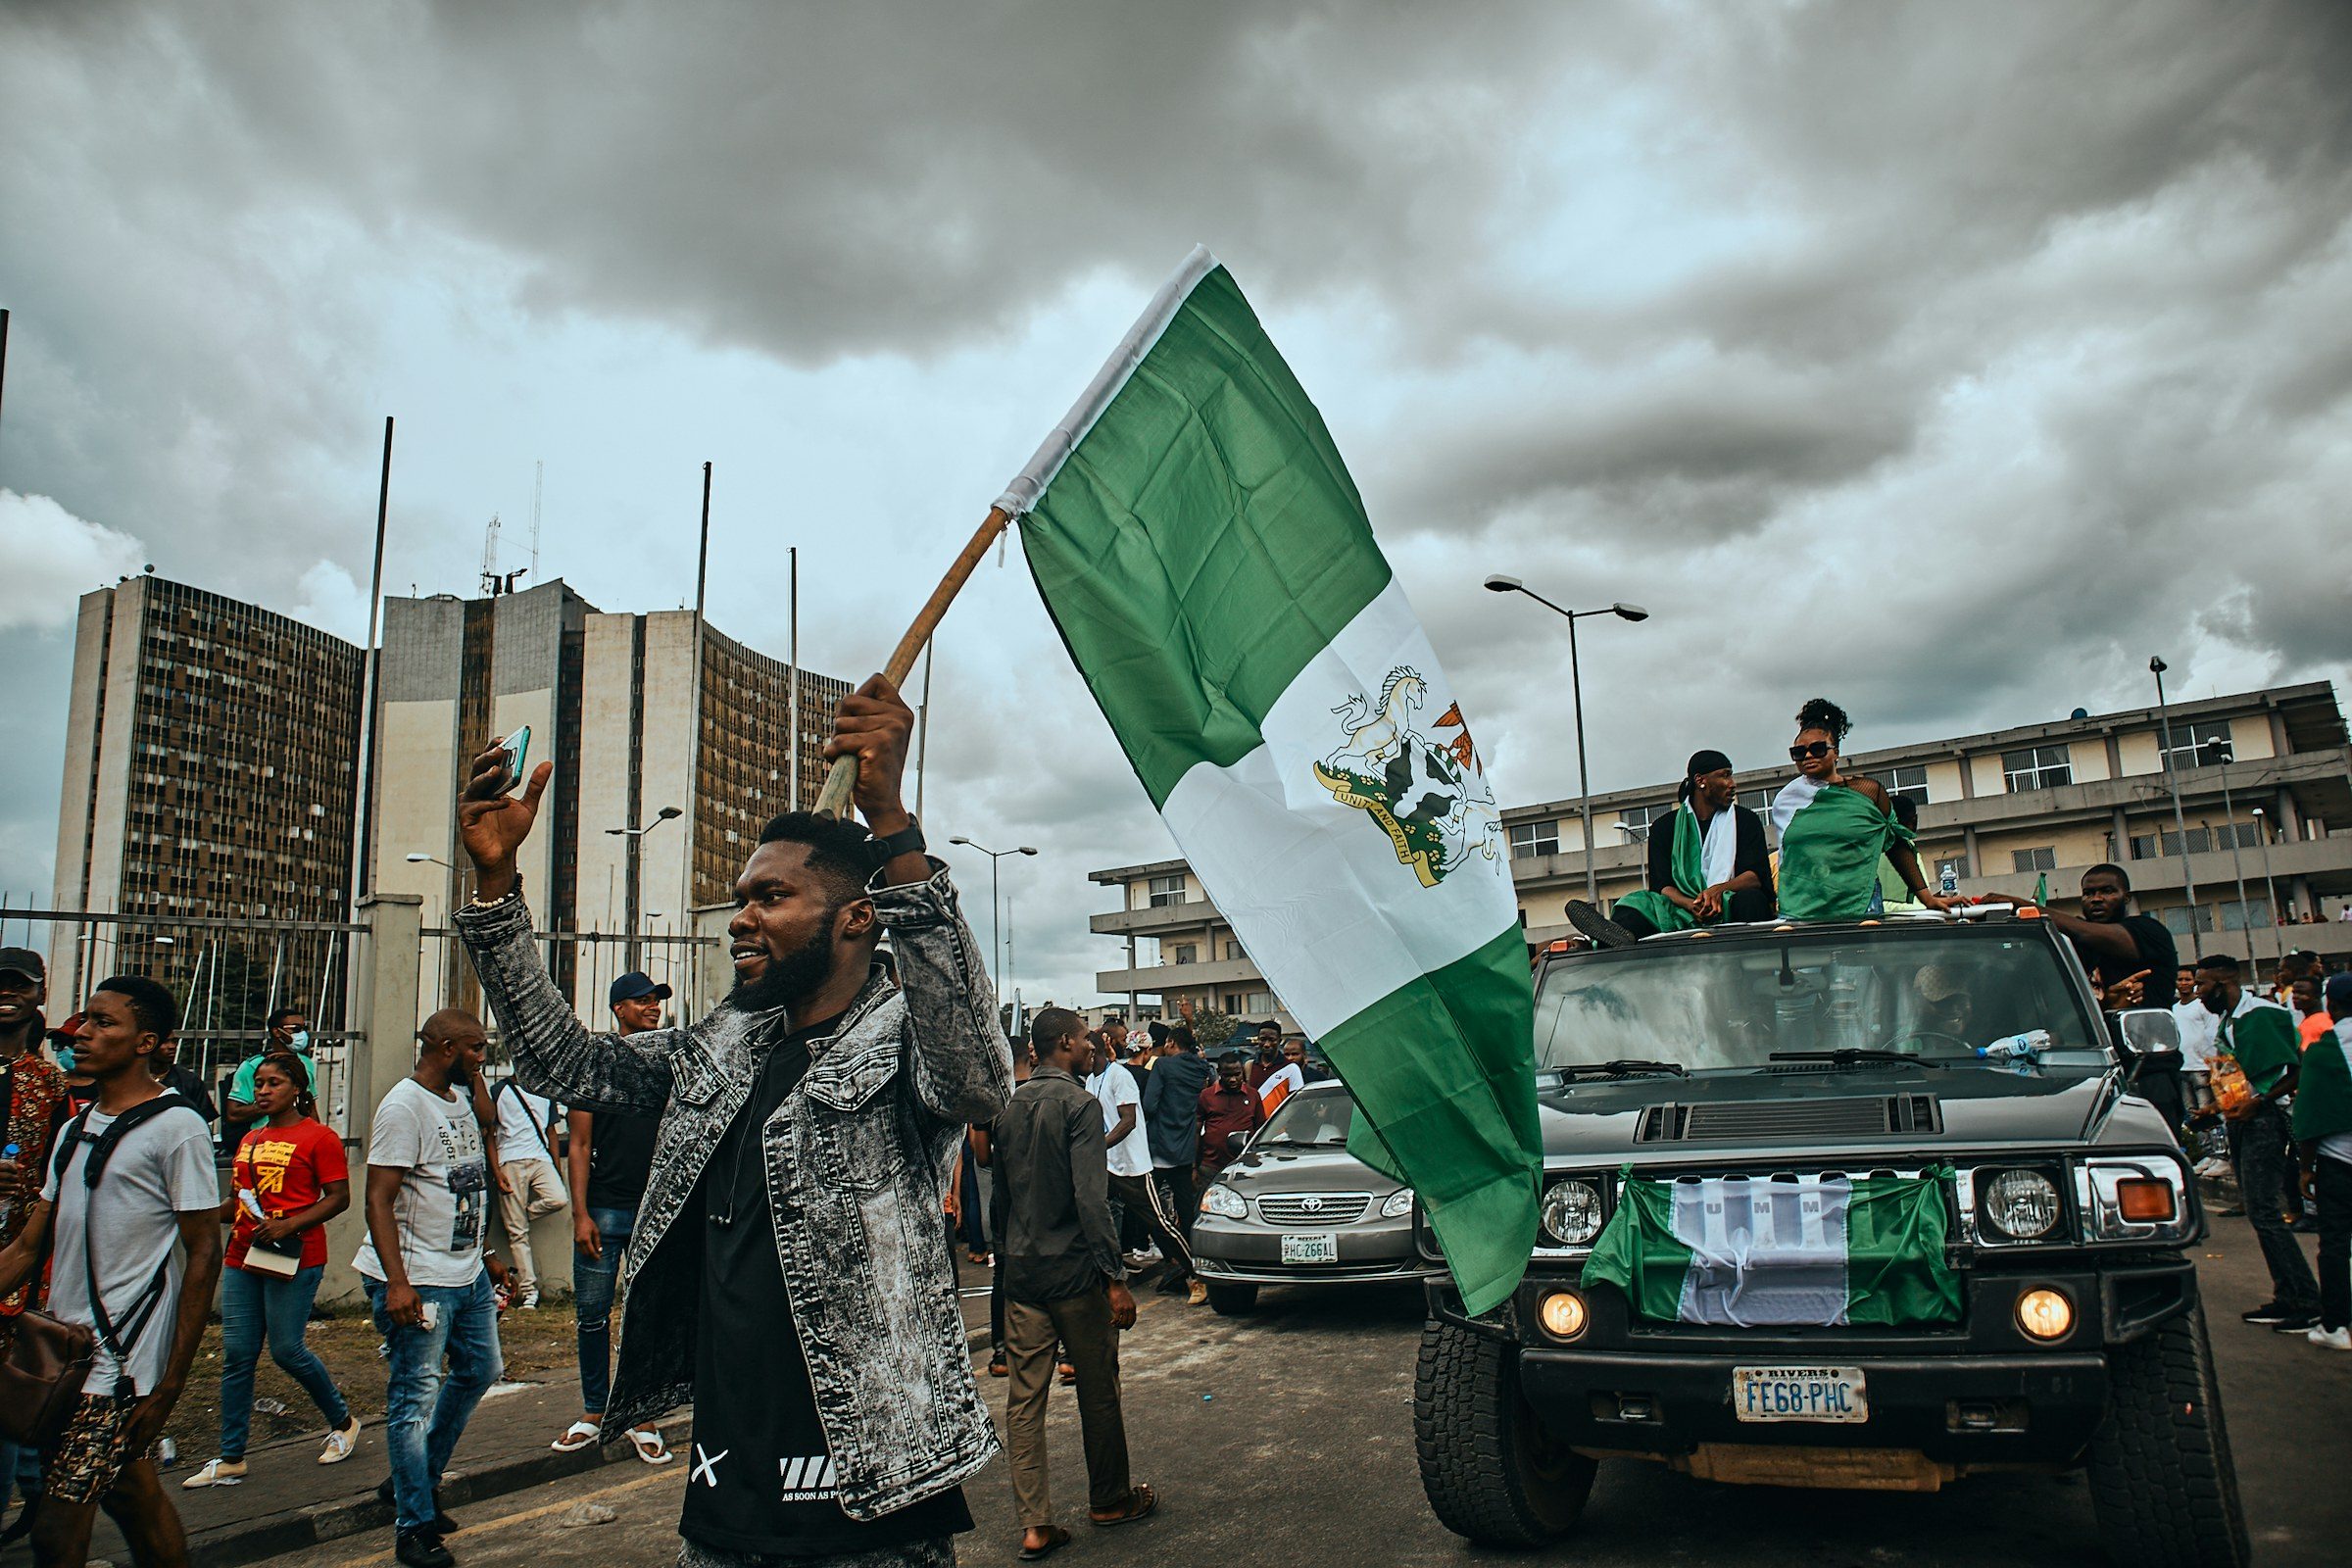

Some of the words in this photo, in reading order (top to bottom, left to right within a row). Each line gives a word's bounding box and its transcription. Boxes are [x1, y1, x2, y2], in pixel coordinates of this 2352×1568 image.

[1374, 808, 1395, 826] AND
[1391, 828, 1410, 858] FAITH
[1746, 1382, 1853, 1412] FE68-PHC
[782, 1493, 794, 1501] AS
[794, 1492, 817, 1501] SOON
[817, 1491, 829, 1500] AS
